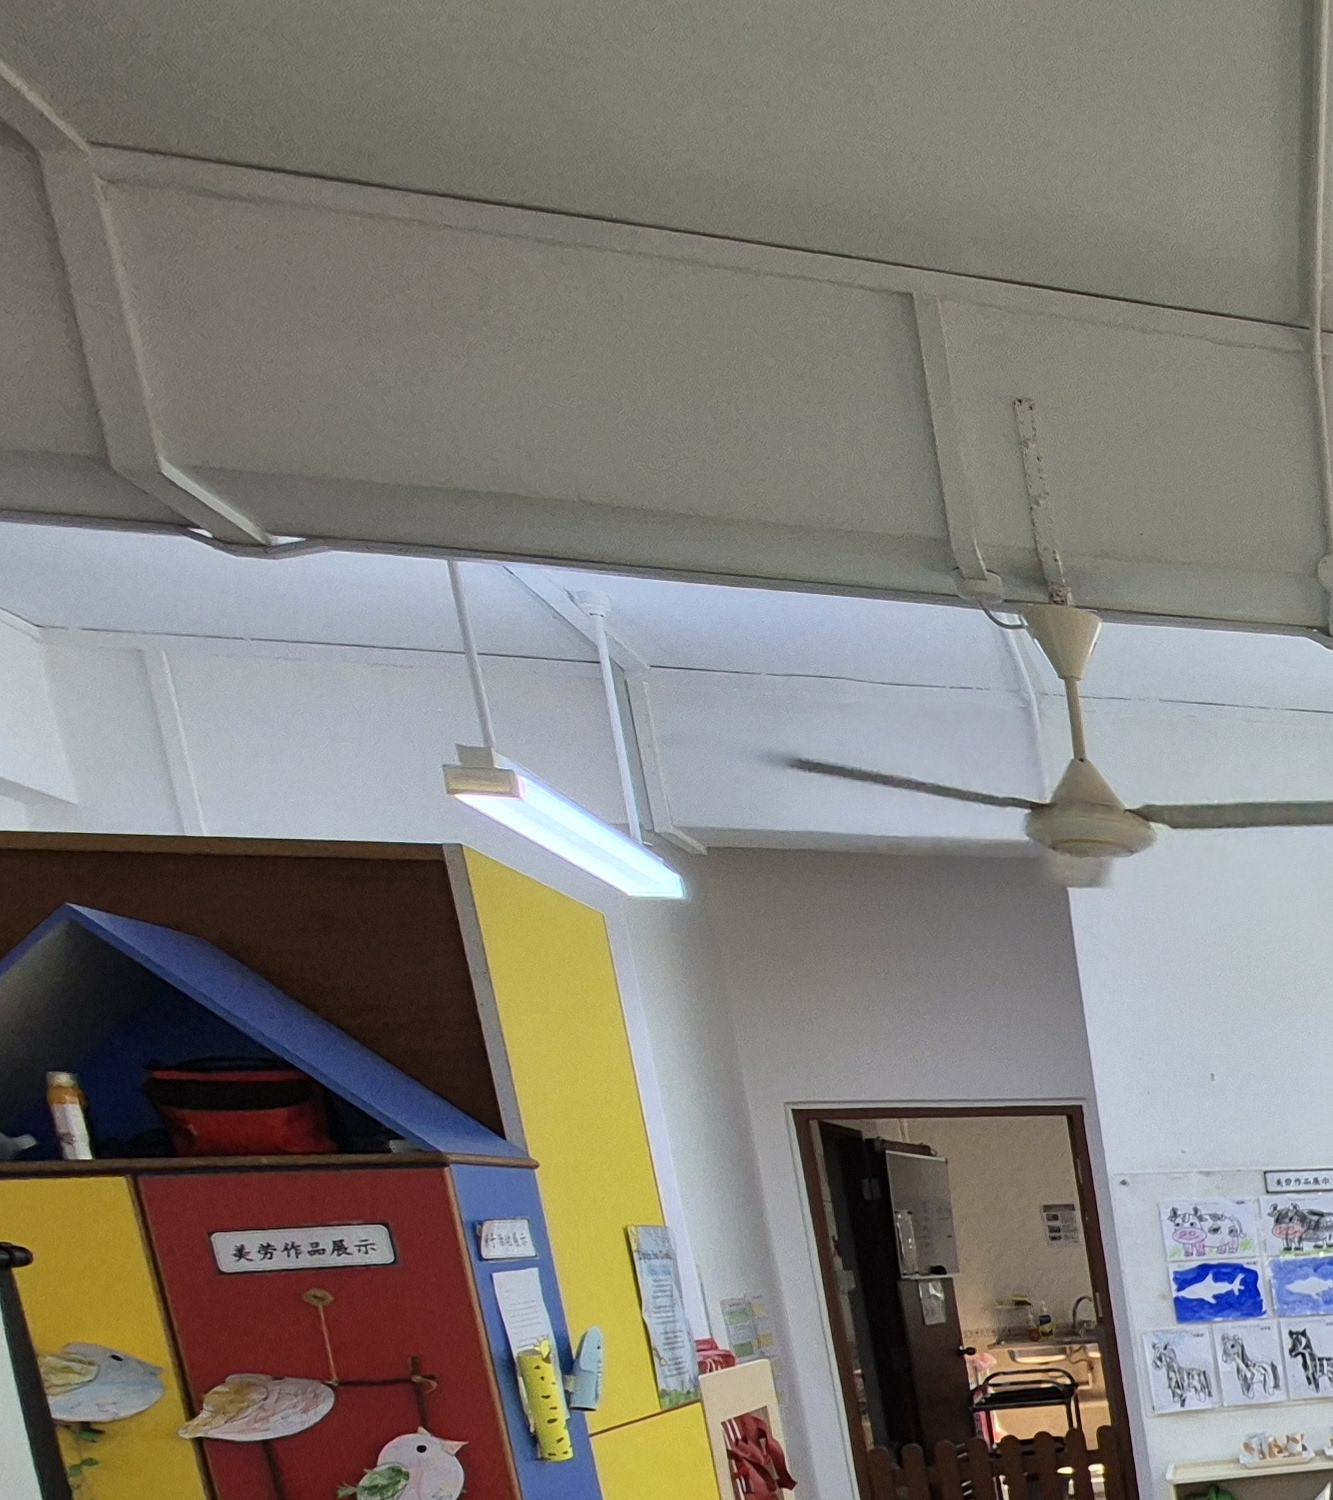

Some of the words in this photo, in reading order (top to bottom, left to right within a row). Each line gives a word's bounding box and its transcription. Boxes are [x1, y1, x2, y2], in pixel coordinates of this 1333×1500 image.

[231, 1238, 379, 1263] 美劳作品展示
